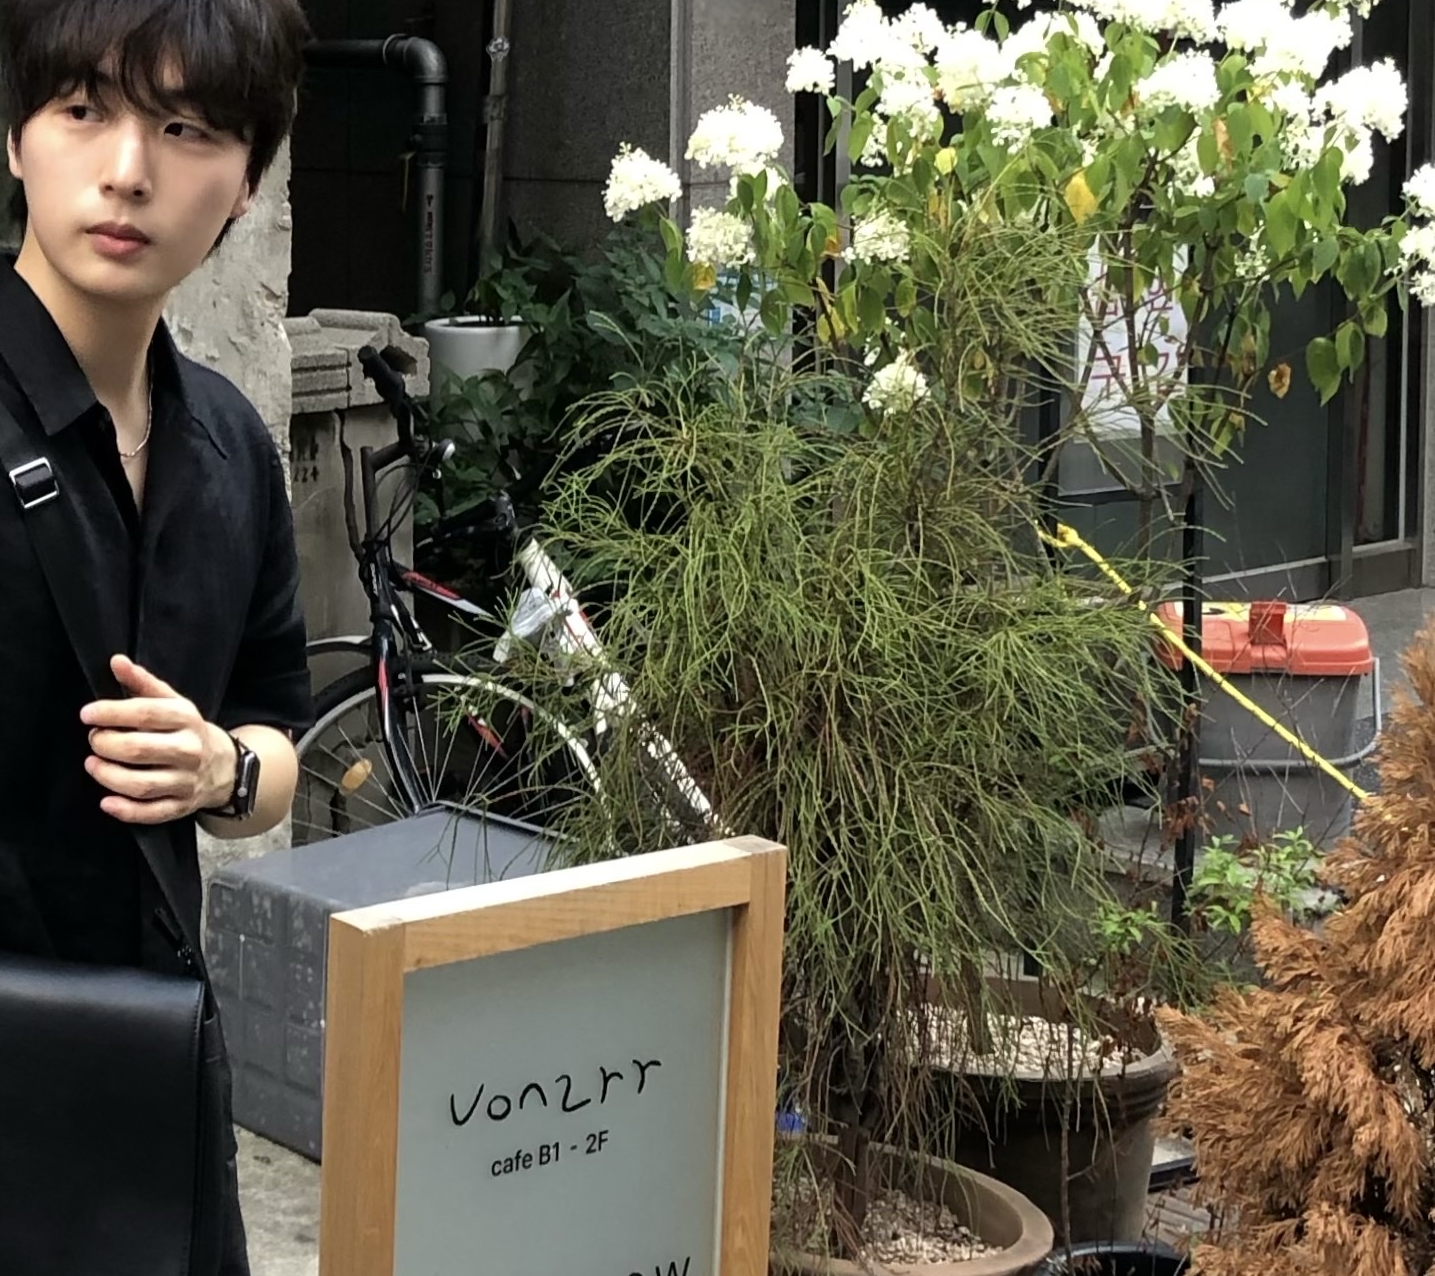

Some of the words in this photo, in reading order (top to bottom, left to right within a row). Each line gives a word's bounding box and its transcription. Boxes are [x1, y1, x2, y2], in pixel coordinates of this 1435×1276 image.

[450, 1059, 662, 1126] vonzrr
[491, 1149, 533, 1177] cafe
[539, 1142, 560, 1166] B1
[585, 1130, 609, 1155] 2F
